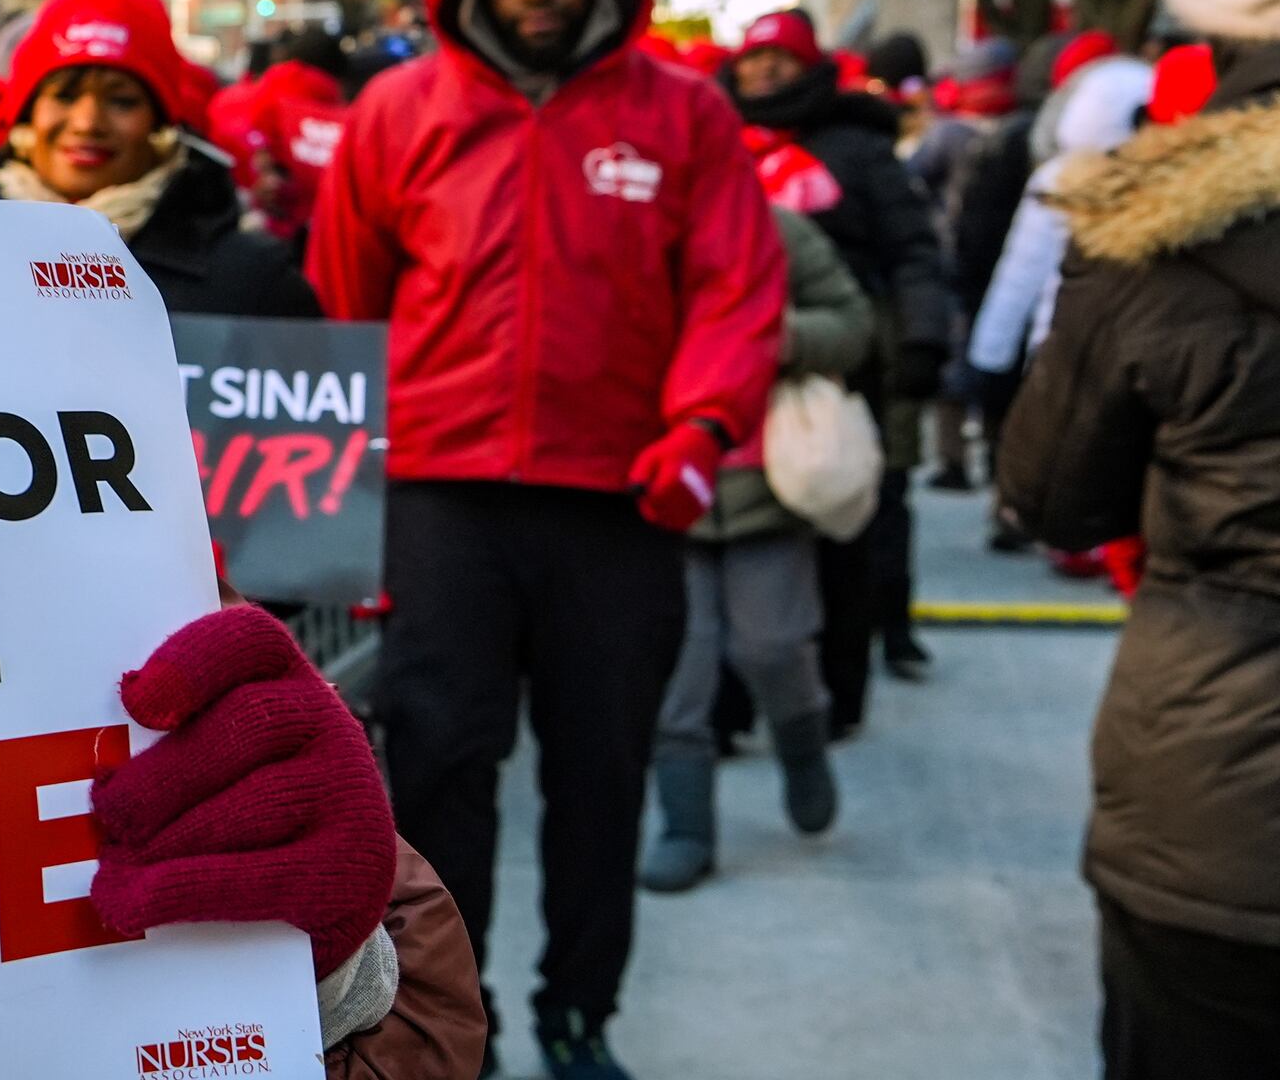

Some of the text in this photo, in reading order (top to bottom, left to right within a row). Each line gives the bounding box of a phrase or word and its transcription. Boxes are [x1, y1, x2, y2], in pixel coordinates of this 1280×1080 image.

[60, 252, 121, 264] New York State
[29, 261, 128, 289] NURSES
[37, 287, 133, 300] ASSOCIATION
[209, 366, 367, 424] SINAI
[178, 1022, 263, 1040] New York State
[135, 1033, 267, 1074] NURSES
[140, 1059, 272, 1080] ASSOCIATION
